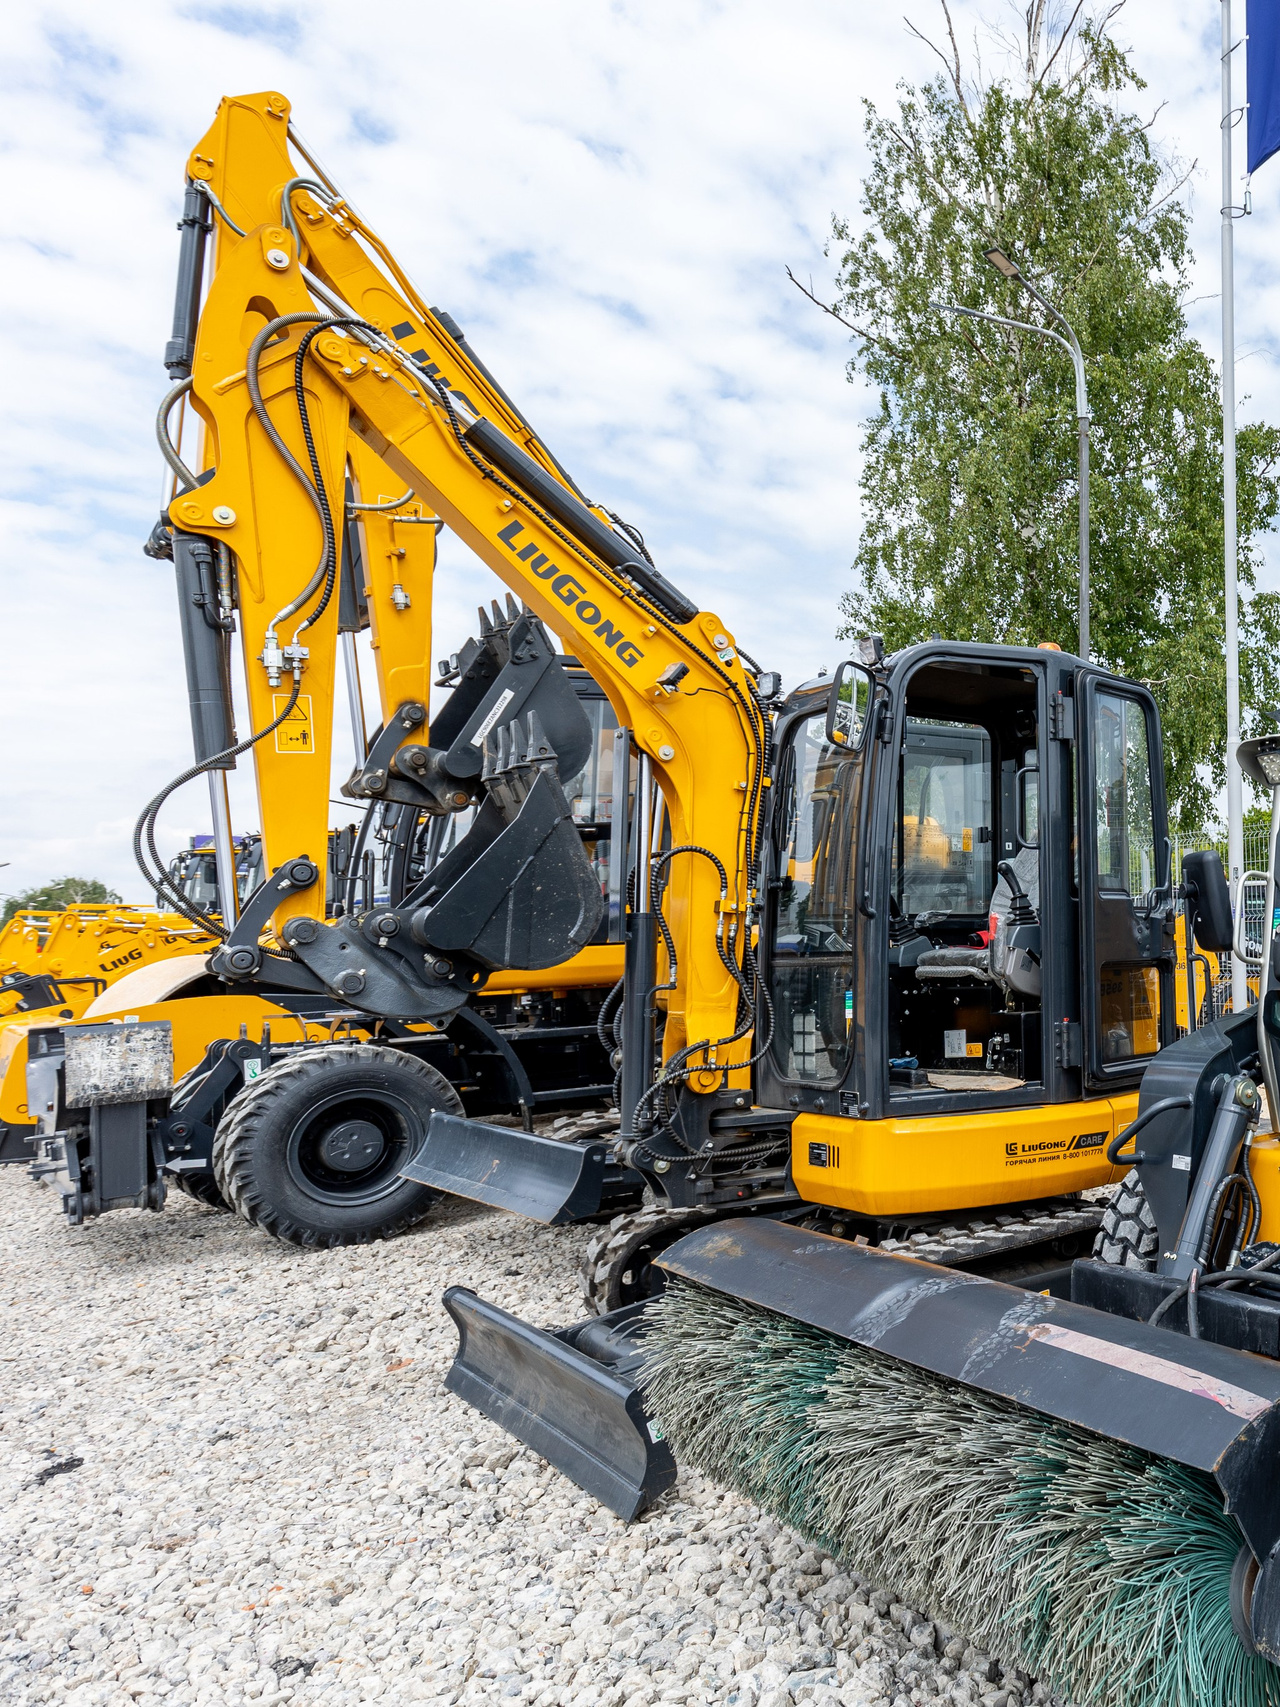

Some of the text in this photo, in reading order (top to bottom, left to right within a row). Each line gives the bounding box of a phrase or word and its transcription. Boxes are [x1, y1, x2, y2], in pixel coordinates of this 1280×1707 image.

[496, 519, 645, 669] LIUGONG
[1080, 1135, 1103, 1146] CARE
[1005, 1157, 1037, 1167] ГОРЯЧАЯ
[1037, 1154, 1061, 1163] ЛИНИЯ
[1062, 1151, 1080, 1160] 8-800
